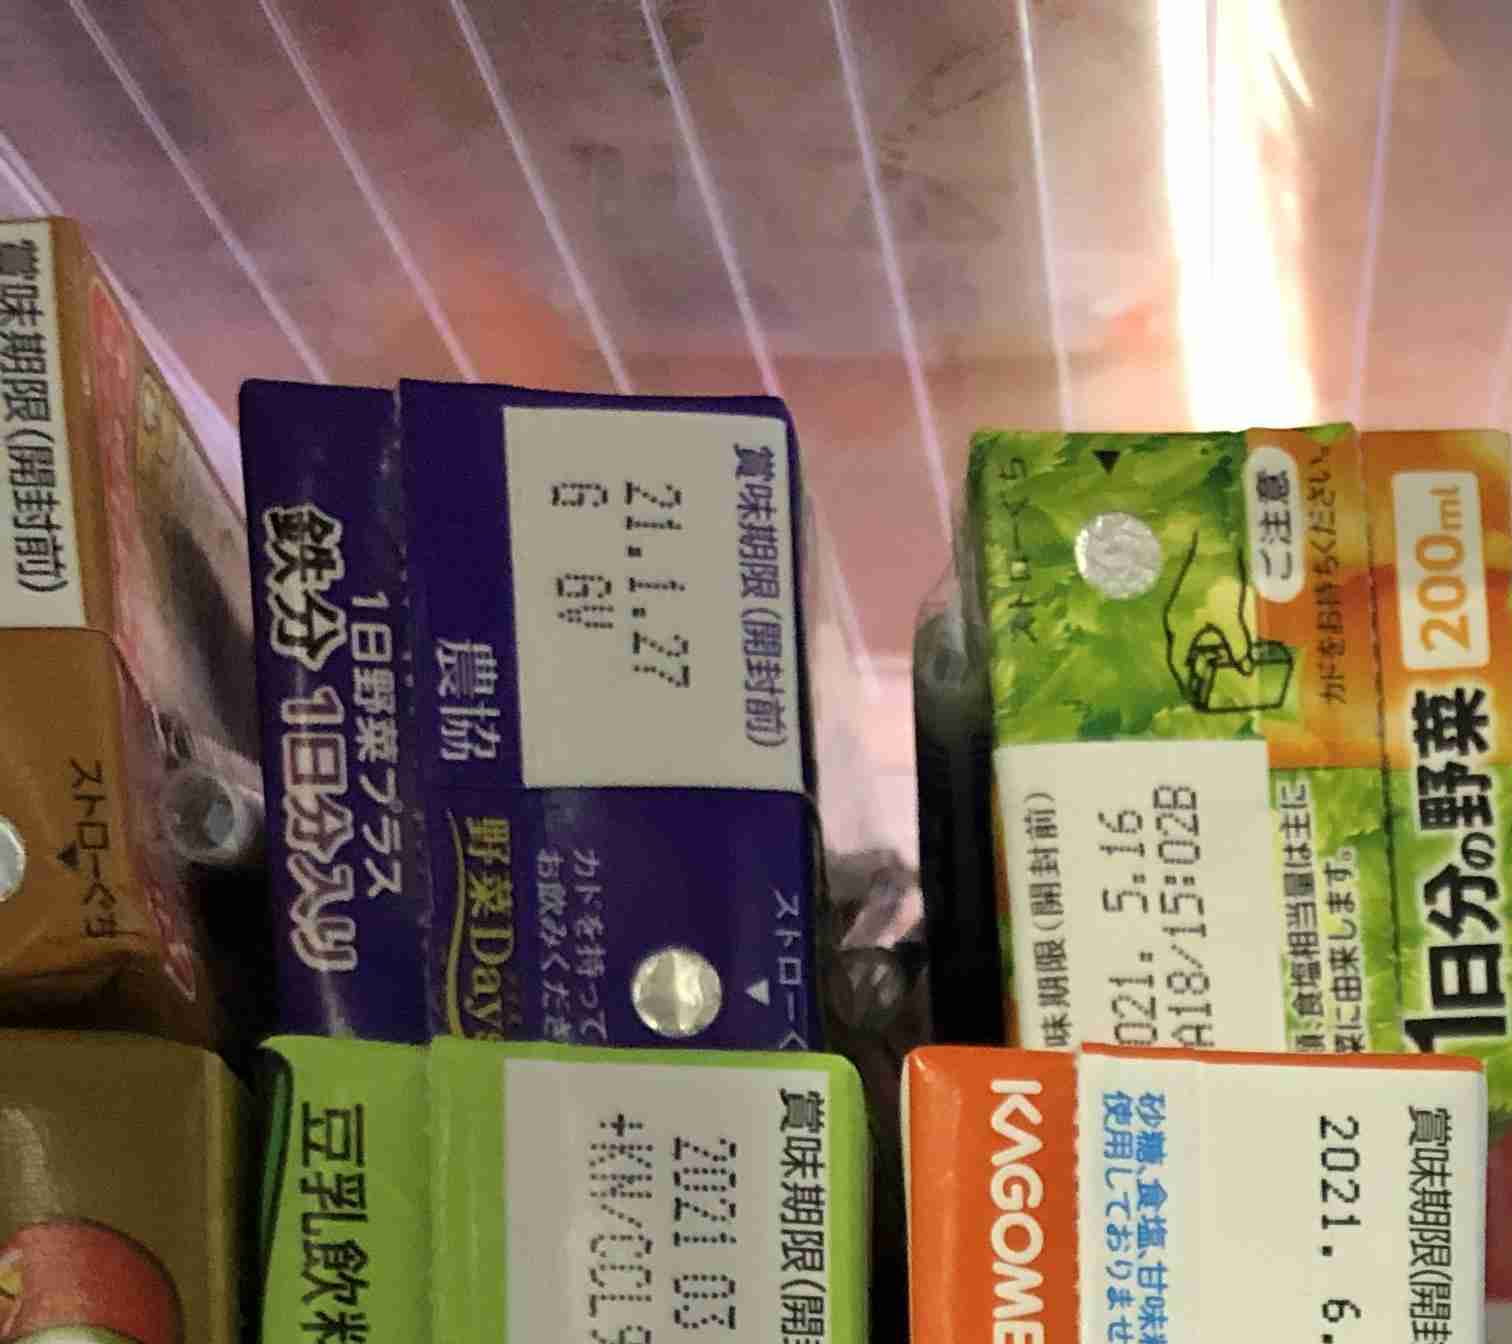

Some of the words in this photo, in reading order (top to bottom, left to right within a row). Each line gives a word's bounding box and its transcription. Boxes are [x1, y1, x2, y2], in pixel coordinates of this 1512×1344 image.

[265, 505, 346, 669] 鉄分
[734, 444, 785, 747] 賞味期限(開封前)
[1256, 469, 1293, 583] ご注意
[1416, 484, 1474, 657] 200ml
[351, 592, 400, 898] 1日野菜プラス
[436, 638, 498, 759] 農協
[281, 686, 356, 972] 1日分入り
[1403, 687, 1508, 1054] 1日分の野菜
[573, 850, 605, 1040] カドを持って
[1023, 790, 1073, 1049] 味期限(開封前)
[1104, 949, 1158, 1048] 021.
[672, 1136, 738, 1247] 2021
[672, 1275, 736, 1330] 03
